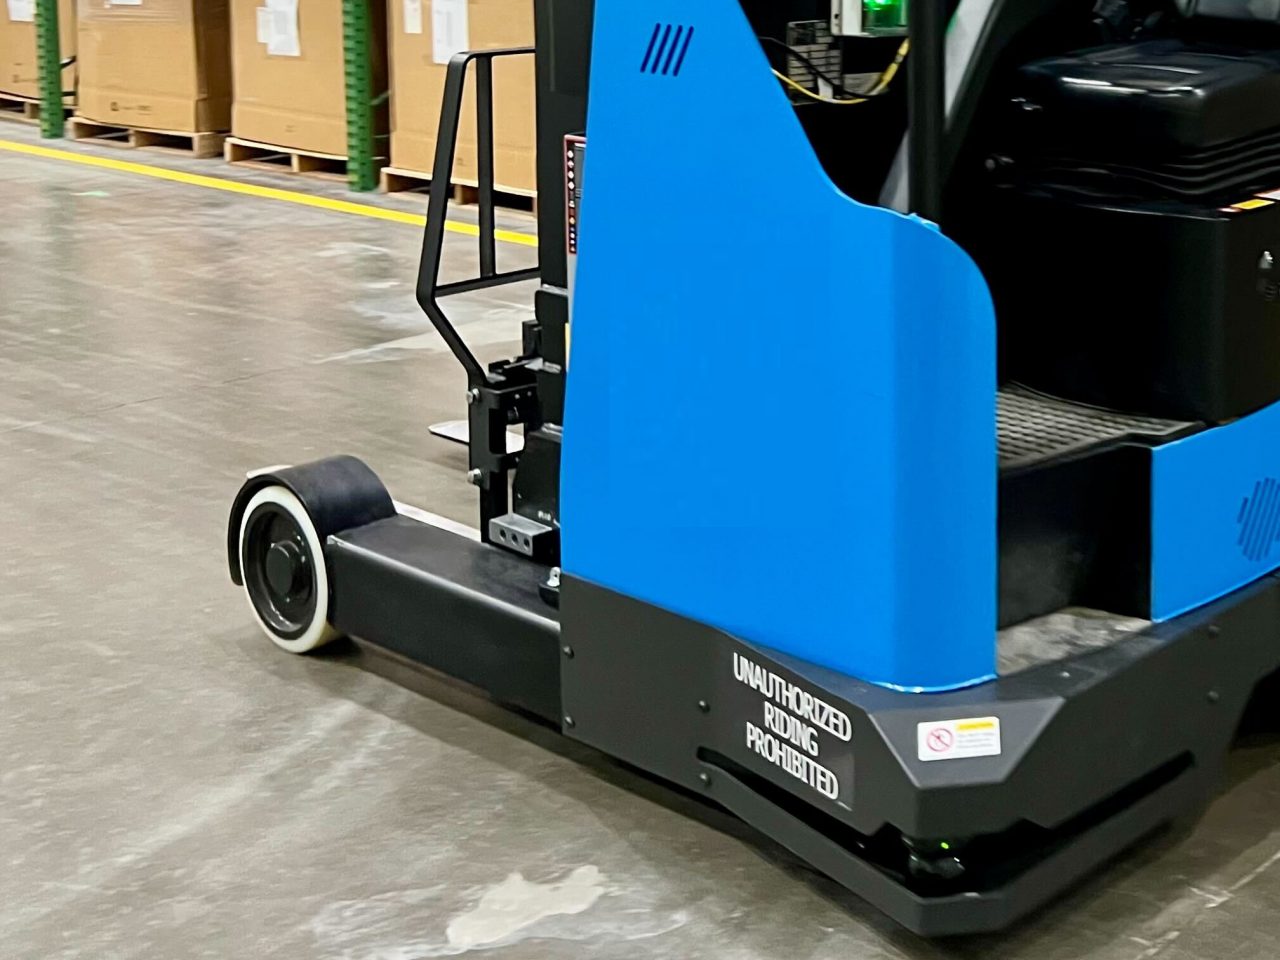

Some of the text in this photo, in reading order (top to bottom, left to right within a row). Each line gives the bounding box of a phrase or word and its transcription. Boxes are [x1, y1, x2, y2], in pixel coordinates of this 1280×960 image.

[733, 651, 853, 742] UNAUTHORIZED
[764, 700, 819, 757] RIDING
[746, 721, 839, 800] PROHIBITED
